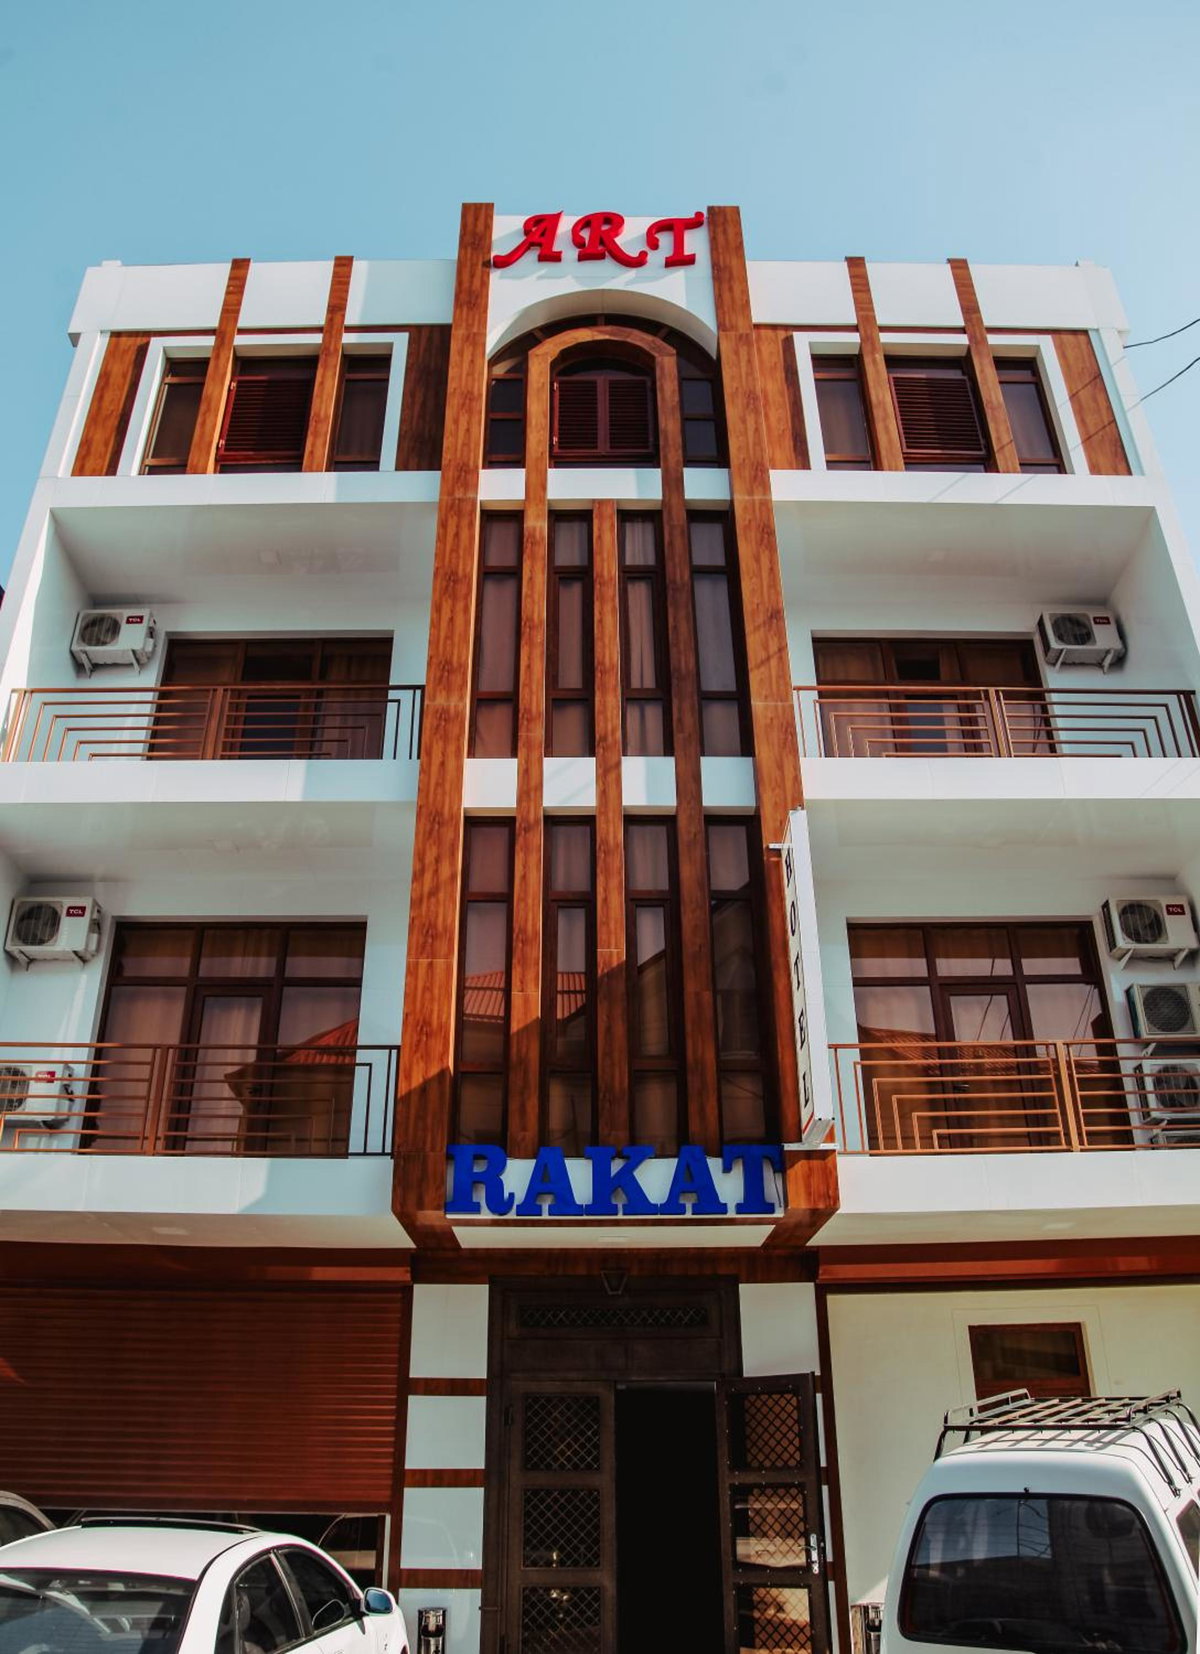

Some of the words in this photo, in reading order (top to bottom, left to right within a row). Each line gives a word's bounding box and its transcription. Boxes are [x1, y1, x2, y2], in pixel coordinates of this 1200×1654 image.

[493, 210, 705, 268] ART
[68, 907, 84, 915] TCL
[785, 845, 810, 1109] HOTEL
[445, 1144, 785, 1216] RAKAT
